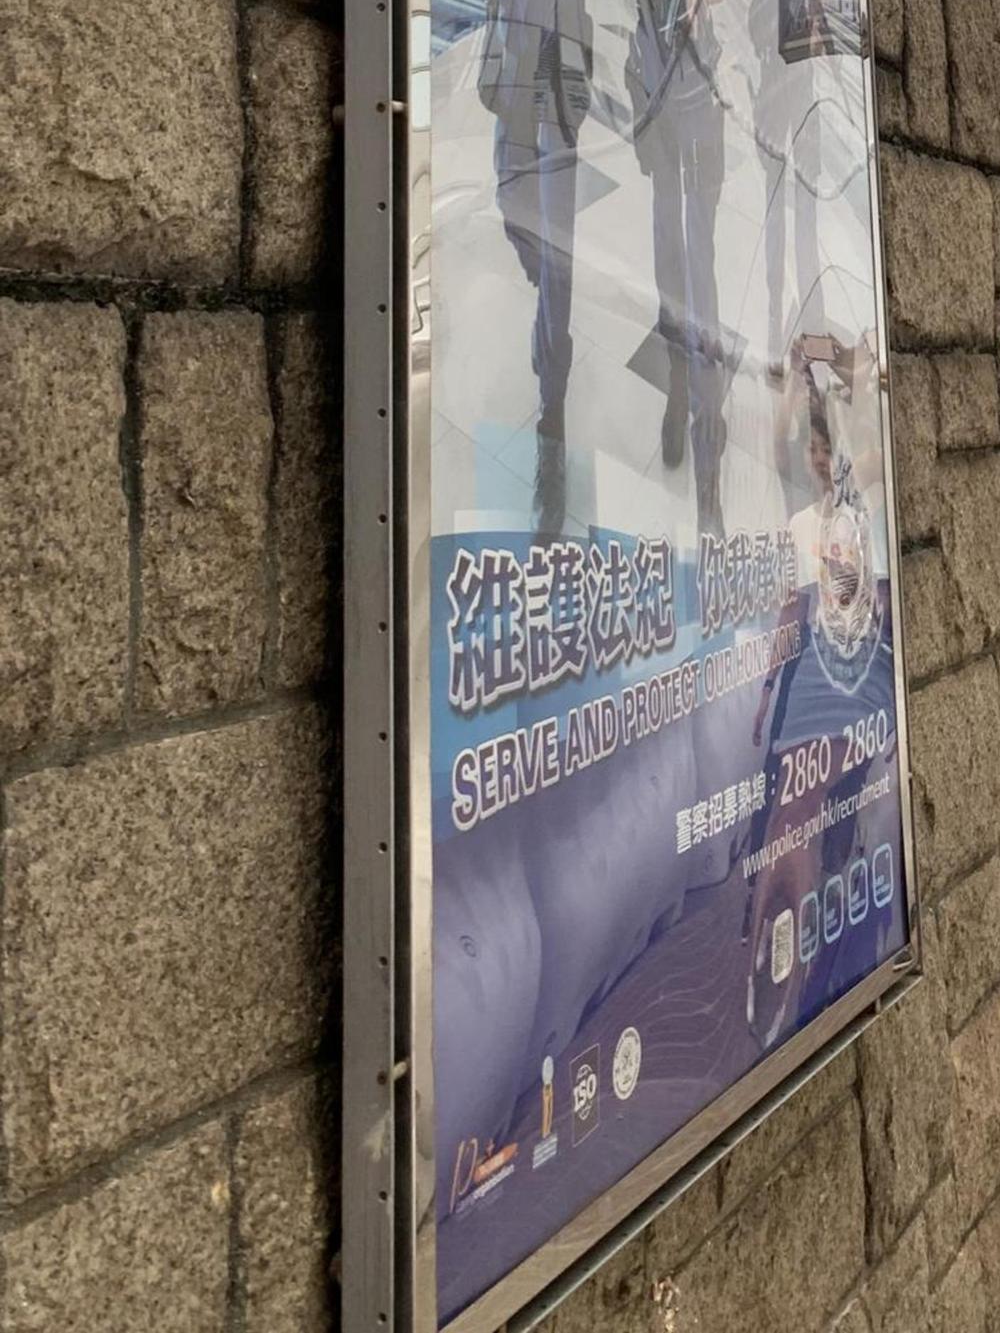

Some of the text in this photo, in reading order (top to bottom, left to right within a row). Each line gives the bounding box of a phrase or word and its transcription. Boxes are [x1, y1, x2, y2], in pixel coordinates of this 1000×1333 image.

[446, 536, 676, 710] 維護法紀
[452, 716, 560, 831] SERVE
[565, 694, 619, 775] AND
[622, 658, 700, 746] PROTECT
[704, 647, 732, 701] OUR
[735, 634, 770, 685] HONG
[780, 735, 831, 806] 2860
[842, 709, 887, 772] 2860
[743, 772, 890, 879] www.police.gov.hk/recruitment
[573, 1074, 597, 1113] ISO
